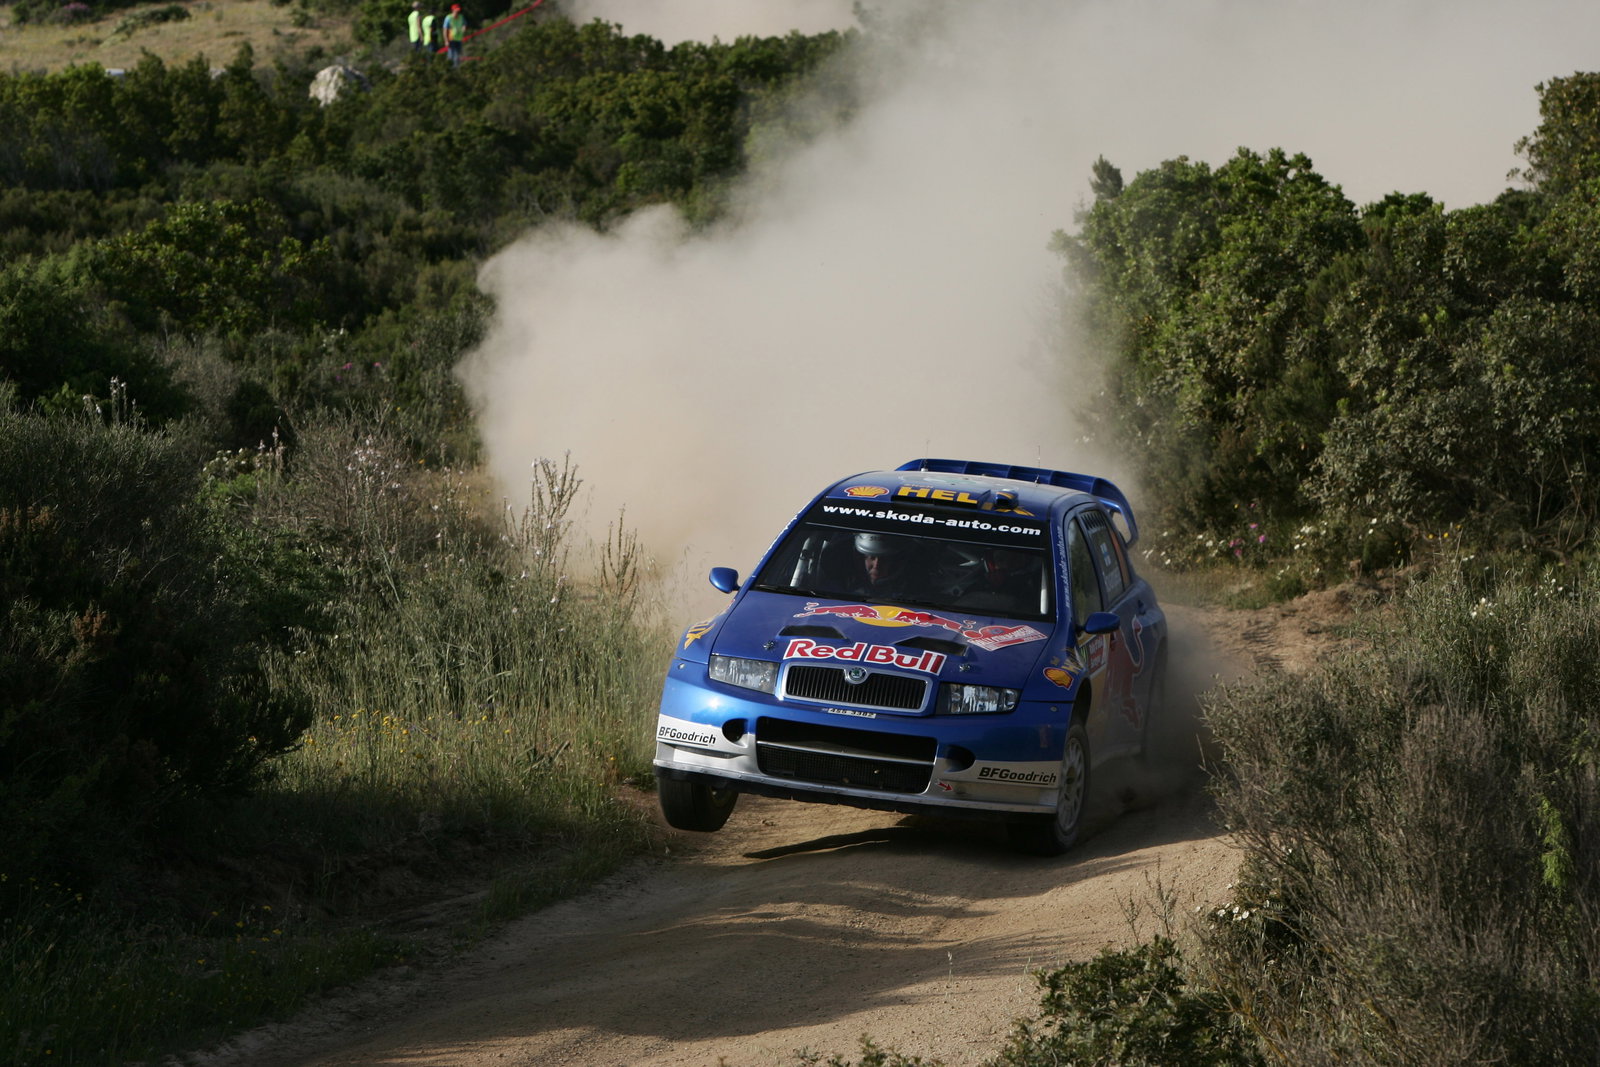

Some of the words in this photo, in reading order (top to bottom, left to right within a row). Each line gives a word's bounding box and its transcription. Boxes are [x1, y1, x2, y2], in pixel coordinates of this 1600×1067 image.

[824, 506, 1041, 535] www.skoda-auto.com
[784, 640, 864, 662] Red
[866, 646, 945, 674] Bull
[658, 727, 716, 745] BFGoodrich
[979, 767, 1057, 783] BFGoodrich
